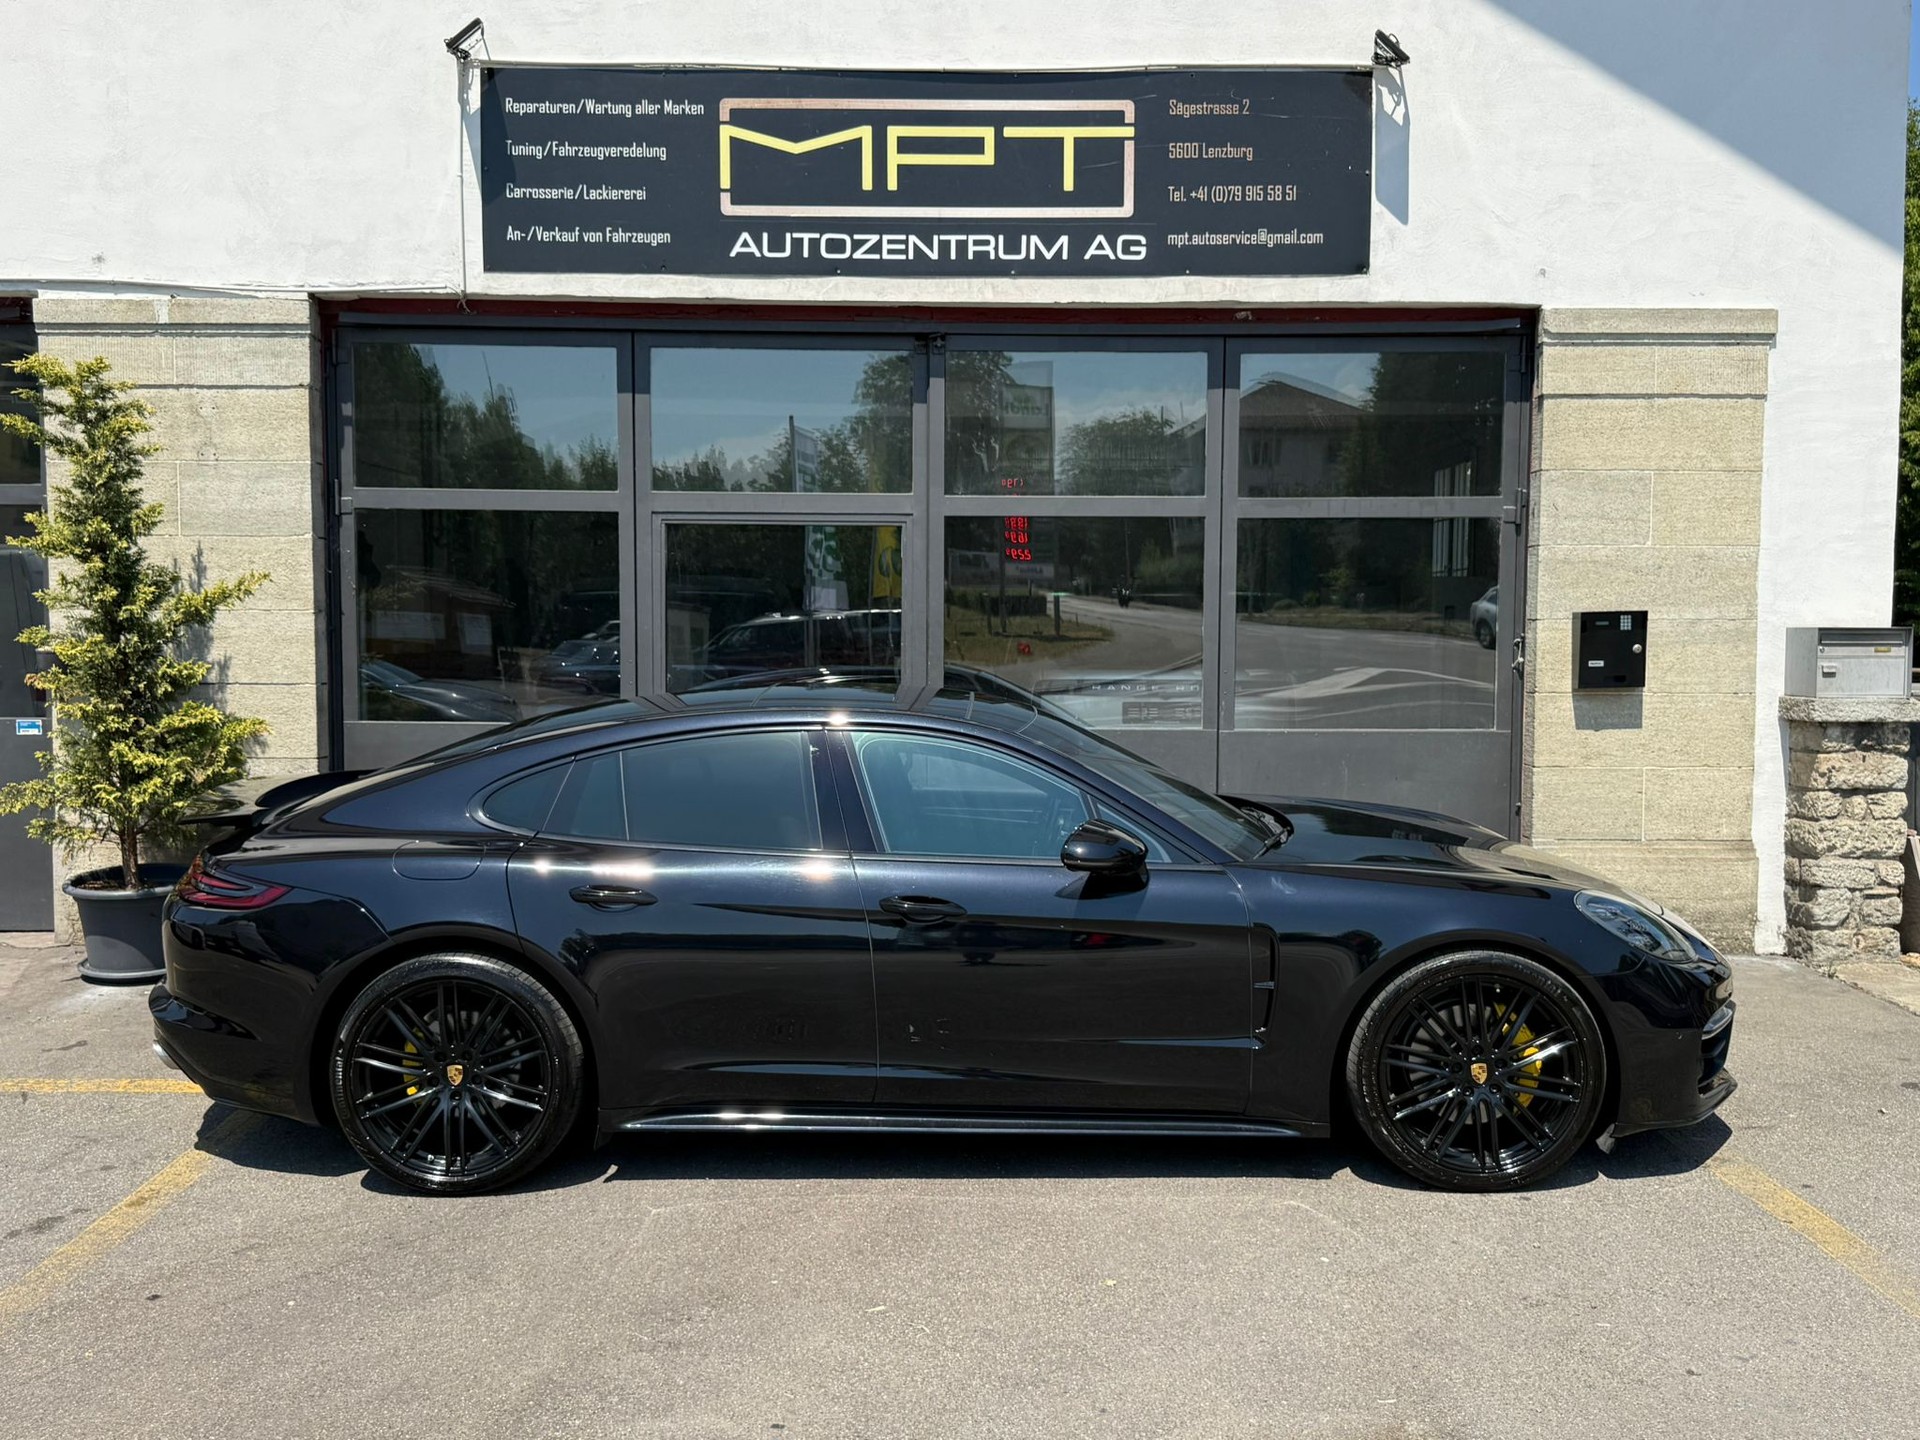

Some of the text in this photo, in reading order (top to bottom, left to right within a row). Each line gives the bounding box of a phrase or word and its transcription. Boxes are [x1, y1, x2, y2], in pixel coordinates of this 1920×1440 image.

[505, 97, 705, 118] Reparaturen/Wartung aller Marken
[1169, 99, 1250, 118] Sägestrasse 2
[505, 140, 667, 161] Tuning/Fahrzeugveredelung
[719, 124, 1135, 191] MPT
[1168, 142, 1253, 161] 5600 Lenzburg
[505, 183, 647, 201] Carrosserie/Lackiererei
[1167, 185, 1297, 204] Tel. +41 (0)79 915 58 51
[506, 225, 671, 247] An-/Verkauf von Fahrzeugen
[1167, 228, 1324, 248] mpt.autoservice@gmail.com
[729, 232, 1148, 261] AUTOZENTRUM AG
